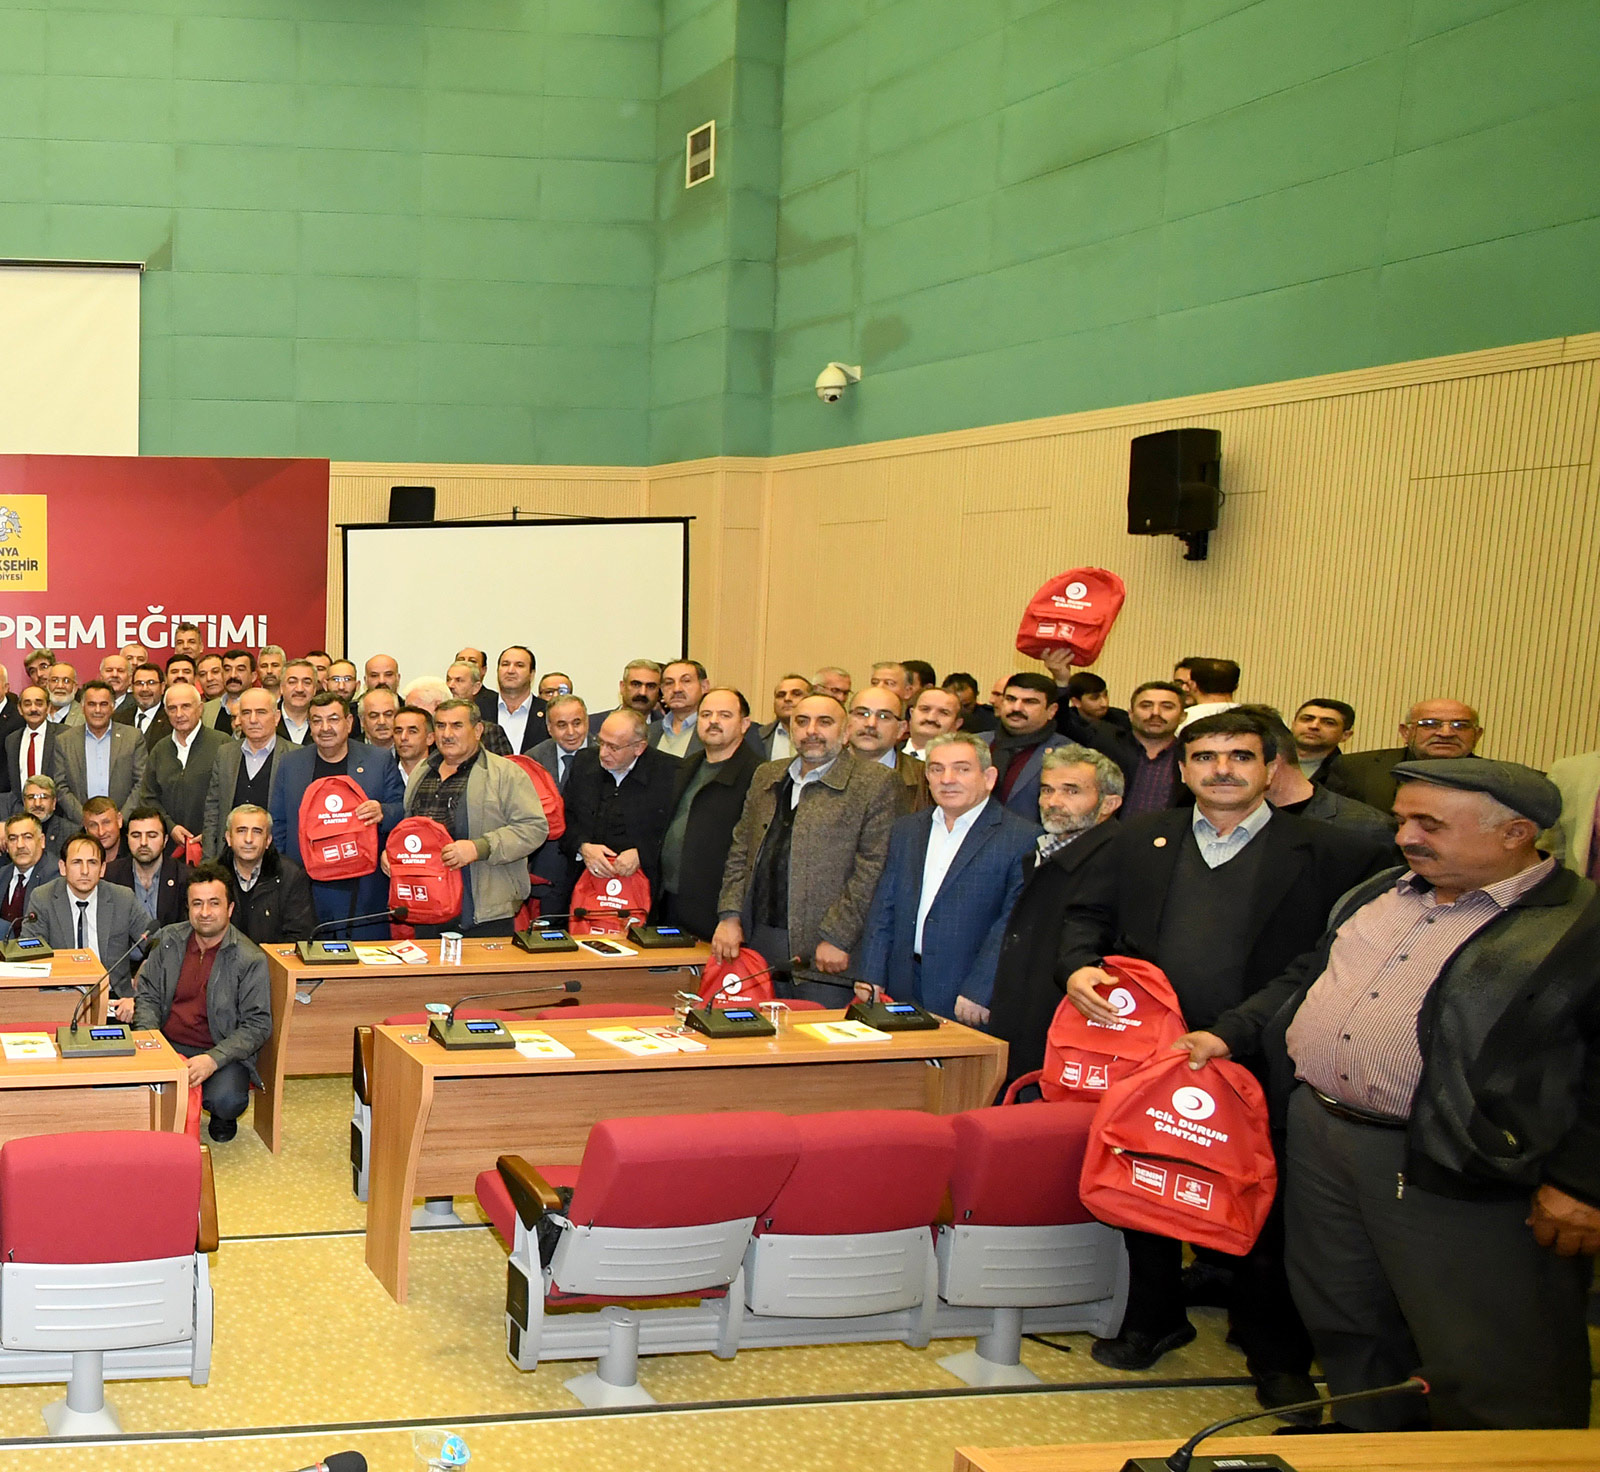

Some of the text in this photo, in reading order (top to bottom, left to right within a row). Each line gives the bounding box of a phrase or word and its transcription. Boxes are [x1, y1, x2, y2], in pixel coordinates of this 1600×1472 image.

[1145, 1107, 1229, 1143] ACİL DURUM
[1154, 1121, 1212, 1148] ÇANTASI
